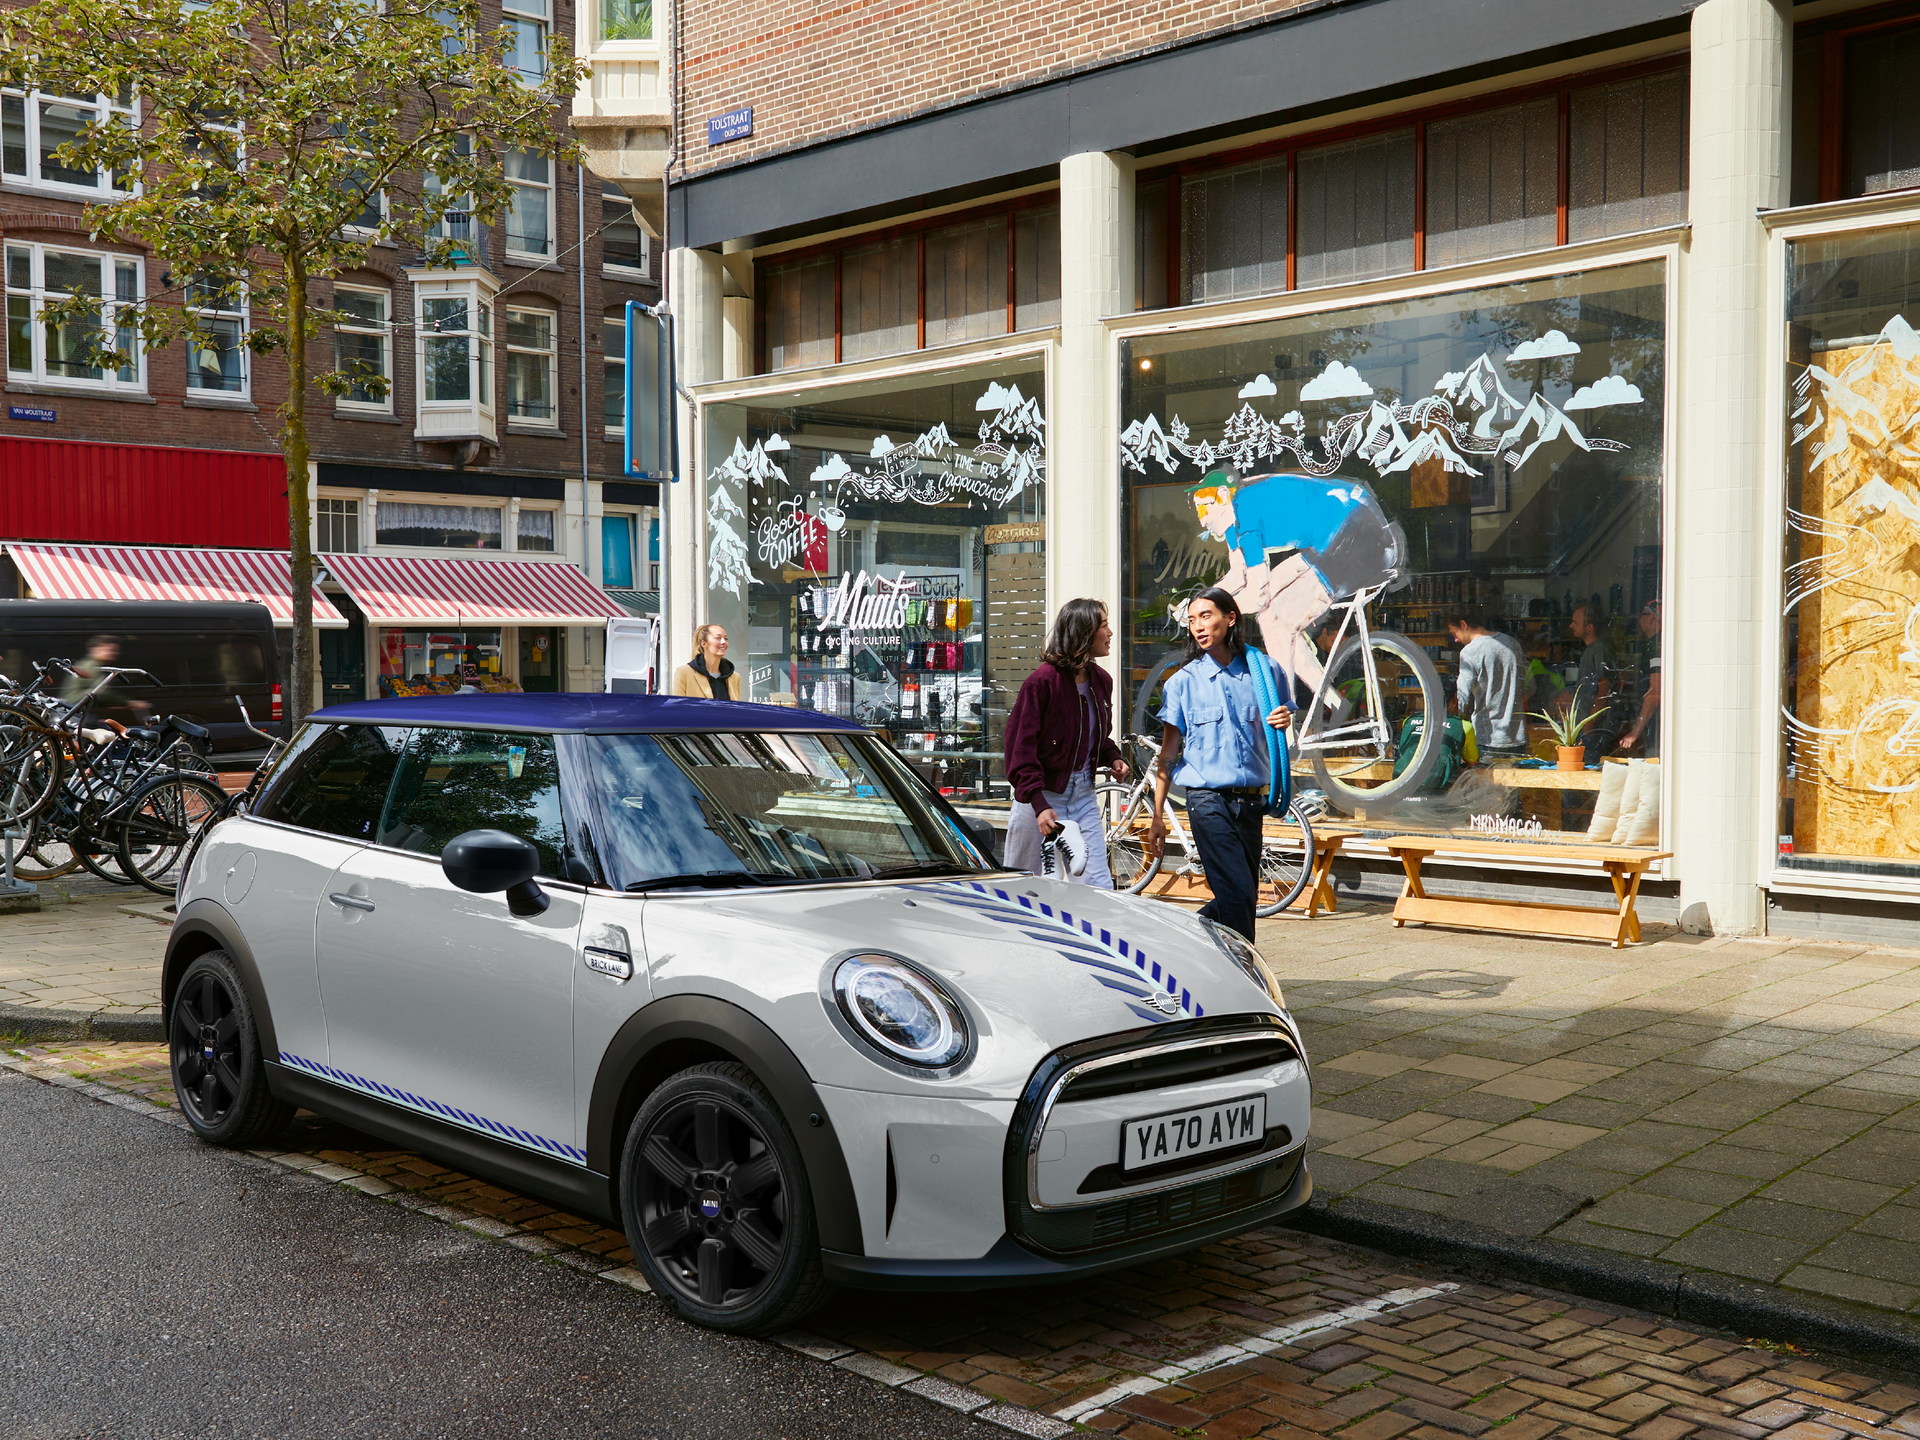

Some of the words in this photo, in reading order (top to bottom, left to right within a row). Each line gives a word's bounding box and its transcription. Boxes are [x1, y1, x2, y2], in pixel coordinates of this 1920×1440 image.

[711, 111, 749, 131] TOLSTRAAT
[724, 125, 749, 138] OUD-ZUID
[12, 407, 24, 415] VAN
[24, 409, 54, 417] WOUSTRAAT
[887, 446, 913, 464] GROUP
[889, 454, 916, 474] RIDES
[954, 453, 976, 473] TIME
[980, 461, 999, 479] FOR
[758, 494, 805, 561] Good
[769, 515, 818, 570] COFFEE
[817, 569, 917, 632] Maats
[862, 635, 901, 646] CULTURE
[591, 958, 608, 969] BRICK
[608, 964, 622, 973] LANE
[1157, 998, 1175, 1006] MINI
[1137, 1115, 1203, 1161] YA70
[1208, 1104, 1255, 1145] AYM
[702, 1199, 719, 1209] MINI
